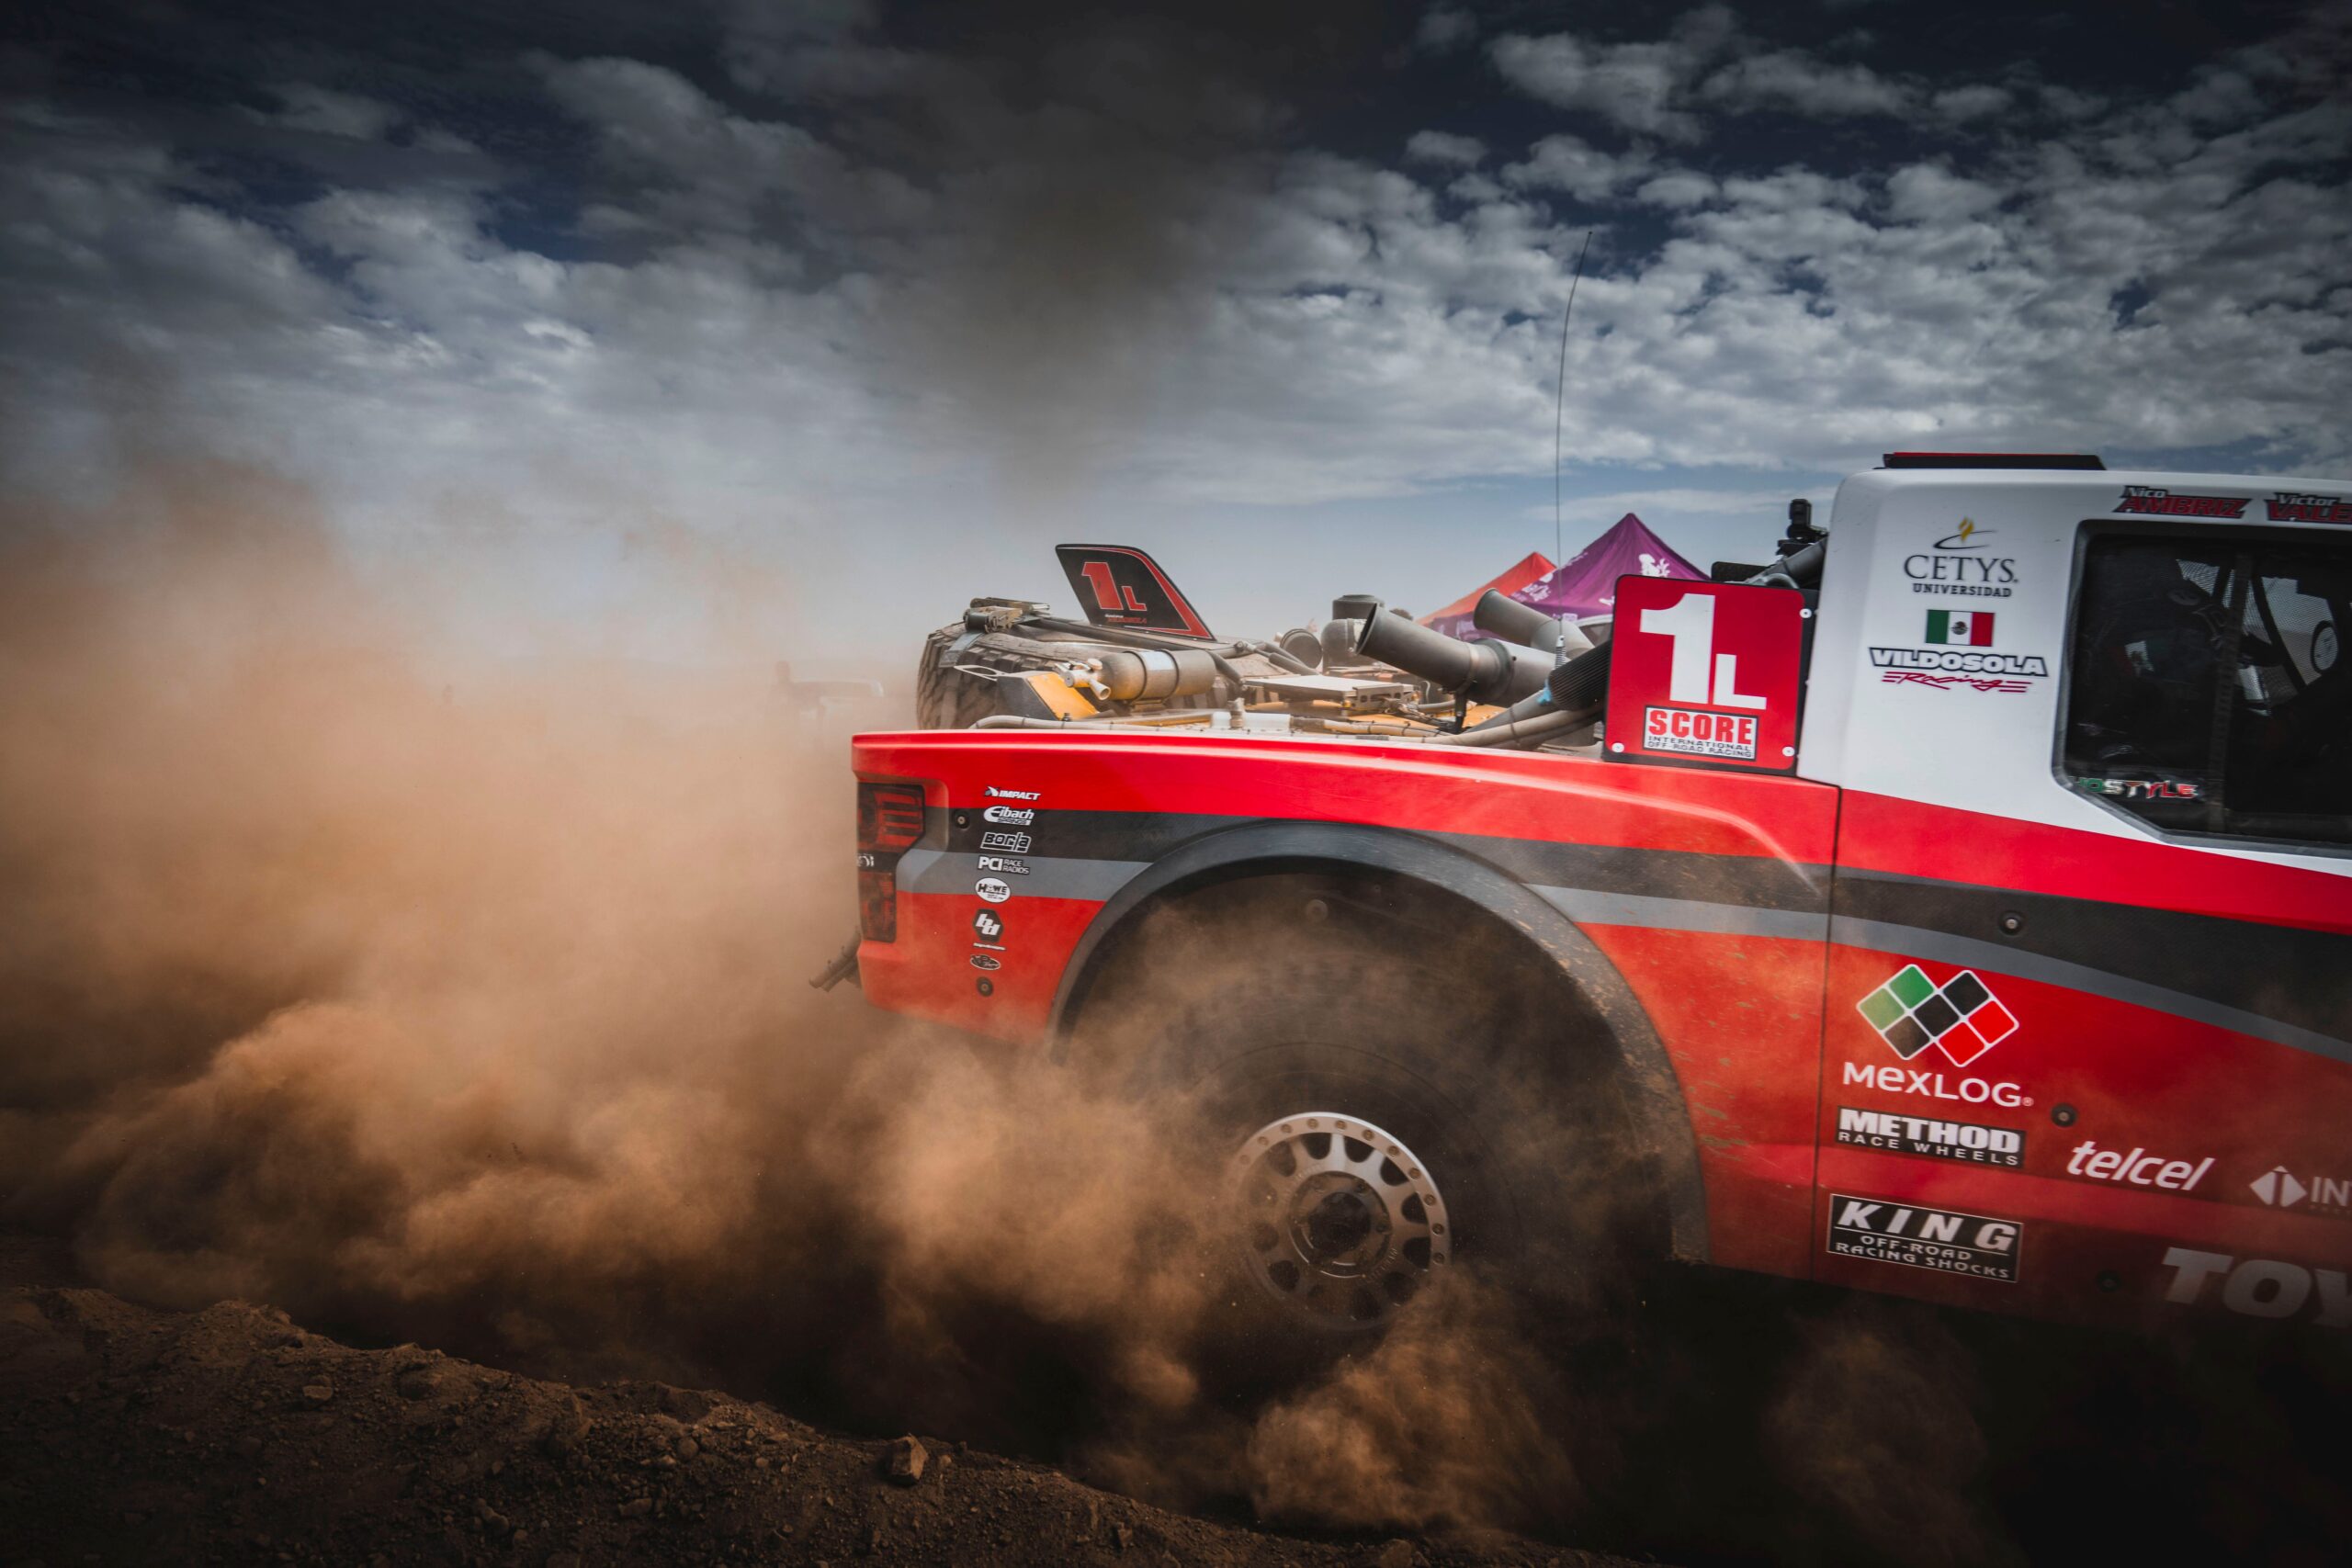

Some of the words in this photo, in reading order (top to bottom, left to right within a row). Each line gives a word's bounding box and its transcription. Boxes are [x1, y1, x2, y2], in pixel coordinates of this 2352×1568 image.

[2117, 495, 2247, 518] AMBRIZ
[2278, 493, 2337, 506] Victor
[1913, 582, 2011, 598] UNIVERSIDAD
[1869, 648, 2048, 677] VILDOSOLA
[1648, 710, 1752, 745] SCORE
[1648, 736, 1751, 751] INTERNATIONAL
[999, 790, 1041, 800] IMPACT
[983, 806, 1035, 825] Eibach
[978, 856, 1002, 871] PCI
[1002, 865, 1029, 874] RADIOS
[1003, 859, 1023, 867] RACE
[1839, 1108, 2020, 1154] METHOD
[1838, 1132, 1899, 1149] RACE
[1914, 1142, 2018, 1167] WHEELS
[2067, 1141, 2216, 1190] telcel
[2311, 1177, 2352, 1207] IN
[1838, 1201, 2017, 1252] KING
[1860, 1235, 1972, 1260] OFF-ROAD
[1836, 1242, 1917, 1263] RACING
[1926, 1257, 2008, 1279] SHOCKS
